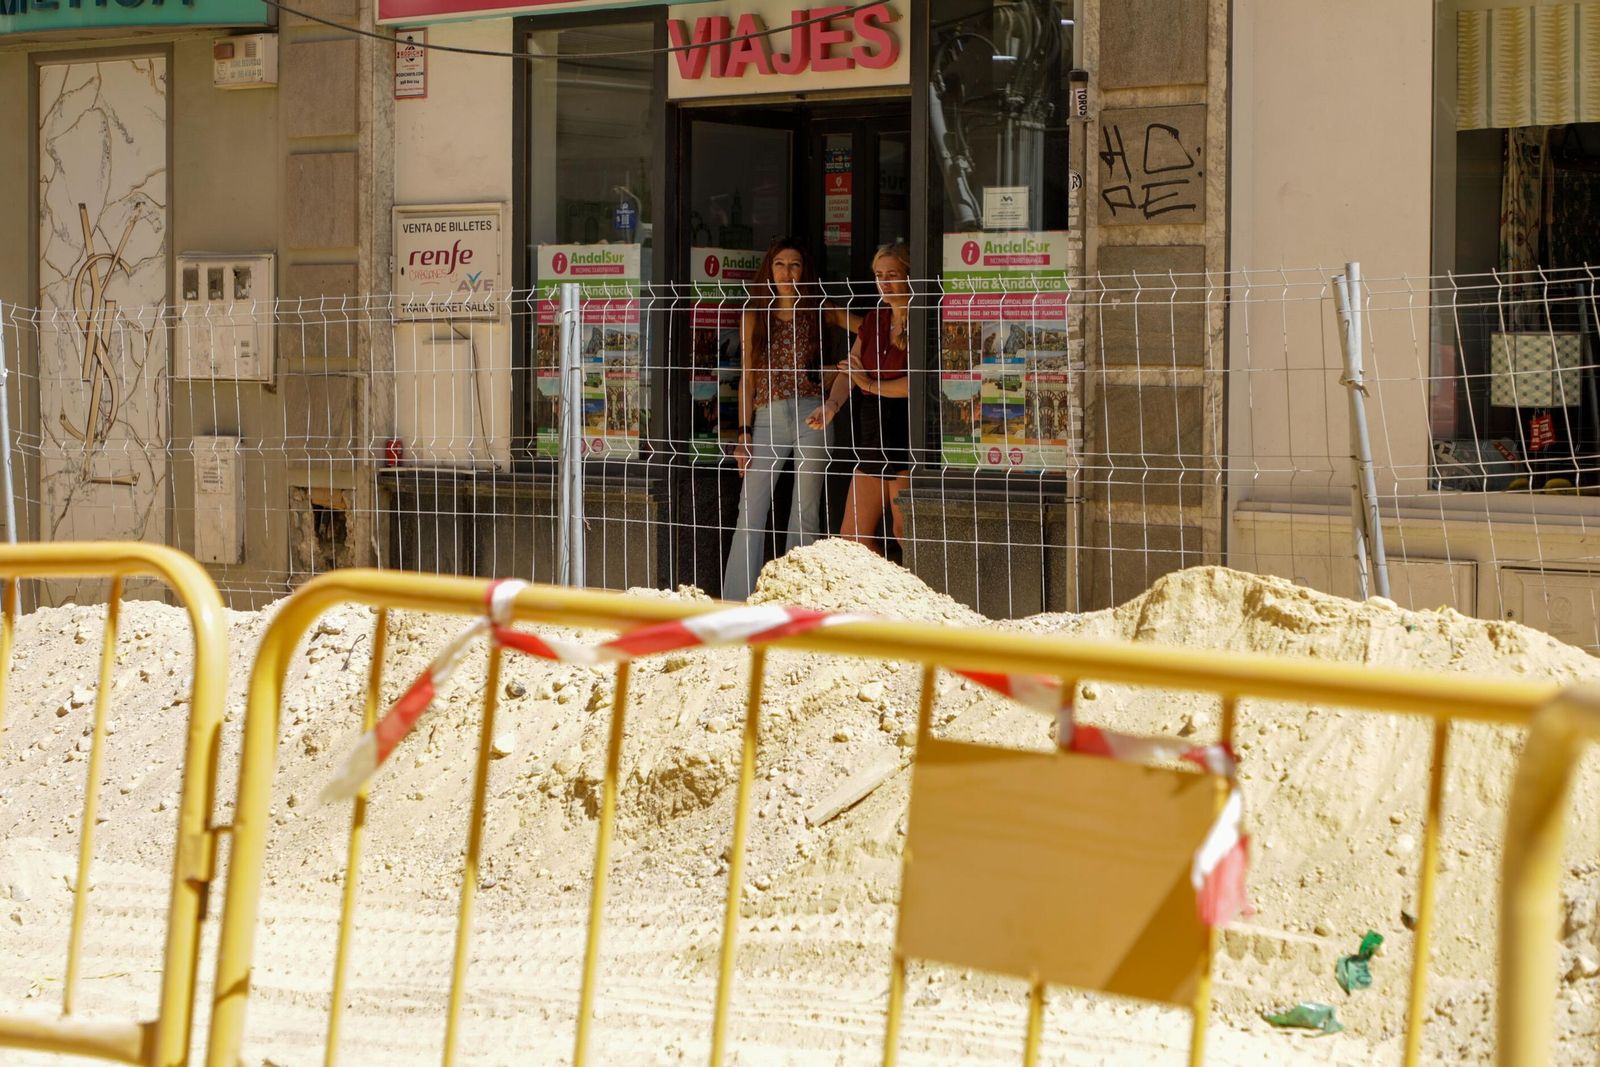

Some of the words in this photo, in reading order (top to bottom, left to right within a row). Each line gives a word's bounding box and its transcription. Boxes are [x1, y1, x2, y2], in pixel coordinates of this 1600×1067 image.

[667, 4, 899, 79] VIAJES
[1077, 89, 1087, 116] TOROS
[403, 223, 432, 233] VENTA
[434, 222, 446, 232] DE
[449, 220, 492, 232] BILLETES
[983, 239, 1050, 254] AndalSur
[409, 240, 474, 275] renfe
[570, 250, 624, 264] AndalSur
[722, 255, 761, 269] AndalS
[457, 271, 494, 293] AVE
[952, 277, 990, 289] Sevilla
[401, 302, 428, 313] TRAIN
[430, 302, 462, 312] TICKET
[465, 302, 495, 312] SALES
